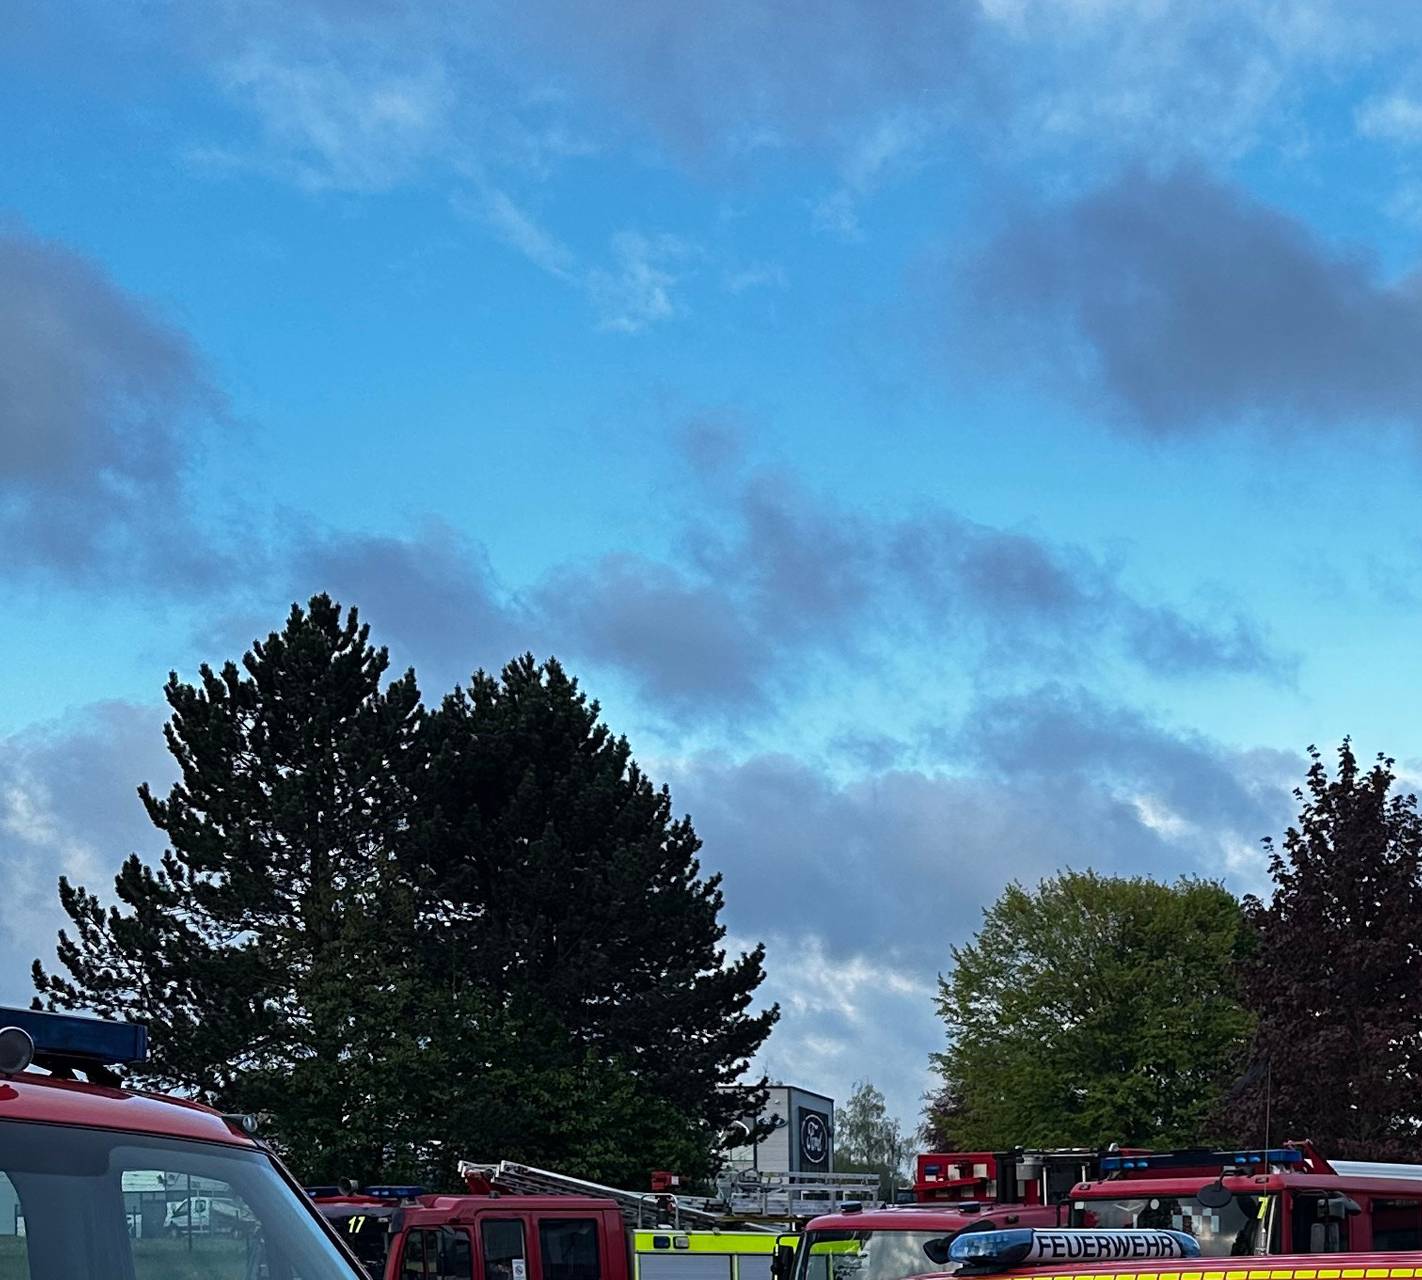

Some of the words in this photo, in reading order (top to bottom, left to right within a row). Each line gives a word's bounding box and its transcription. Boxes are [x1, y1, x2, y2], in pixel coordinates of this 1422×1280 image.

[1256, 1196, 1269, 1219] 7
[348, 1215, 366, 1234] 17
[1035, 1235, 1174, 1258] FEUERWEHR
